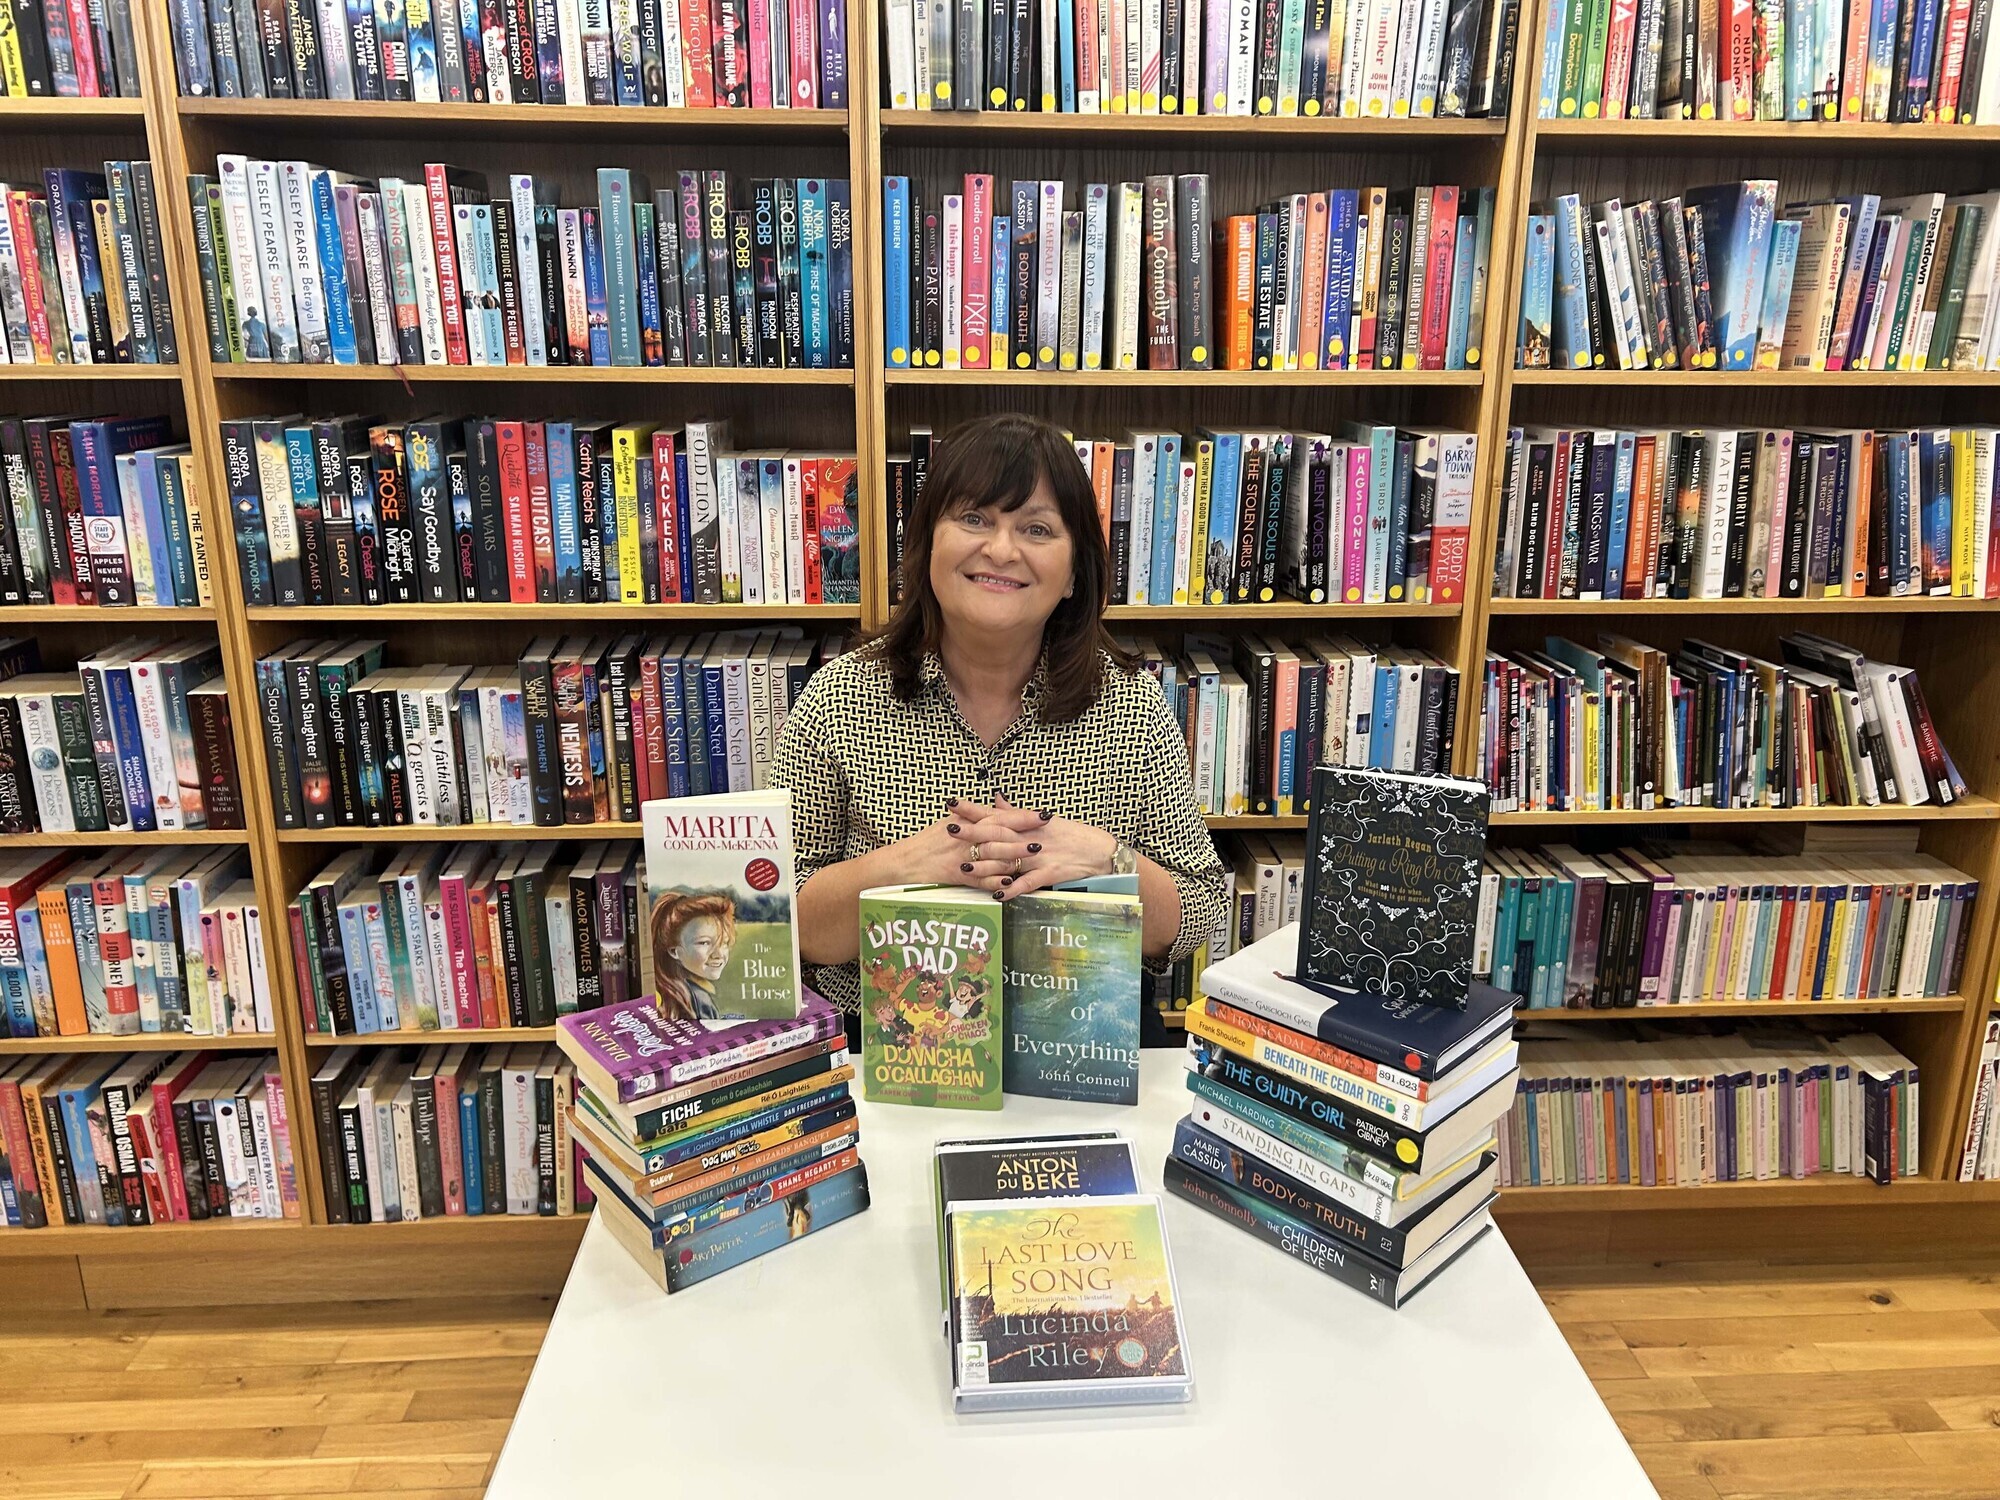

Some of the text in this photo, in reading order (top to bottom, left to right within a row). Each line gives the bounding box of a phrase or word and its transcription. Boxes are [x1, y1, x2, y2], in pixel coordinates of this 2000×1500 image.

[263, 9, 277, 58] PARETSKY
[270, 20, 281, 46] SARA
[390, 41, 409, 82] COUNT
[256, 172, 287, 329] LESLEY PEARSE Suspects
[1152, 198, 1169, 321] John Connolly
[1916, 208, 1941, 285] breakdown
[293, 222, 318, 323] PEARSE Betrayal
[926, 266, 938, 306] PARK
[1328, 237, 1344, 324] FIFTH AVENUE
[964, 294, 987, 338] FIXER
[1260, 264, 1272, 331] THE ESTATE
[693, 439, 709, 525] OLD LION
[1688, 449, 1701, 495] WINDFALL
[1737, 450, 1751, 529] THE MAJORITY
[376, 469, 399, 521] ROSE
[657, 447, 674, 554] HACKER
[1264, 468, 1283, 561] BROKEN SOULS
[1313, 469, 1325, 558] SILENT VOICES
[1353, 452, 1366, 551] HAGSTONE
[1708, 439, 1732, 558] MATRIARCH
[508, 495, 526, 580] SALMAN RUSHDIE
[530, 485, 551, 554] OUTCAST
[555, 483, 575, 557] MANHUNTER
[1240, 485, 1258, 568] STOLEN GIRLS
[66, 512, 91, 583] SHADOW STATE
[92, 558, 124, 566] APPLES
[243, 527, 261, 592] NIGHTWORK
[335, 538, 350, 579] LEGACY
[359, 536, 374, 581] Cheater
[1435, 537, 1450, 584] DOYLE
[1451, 537, 1466, 585] RODDY
[96, 566, 123, 574] NEVER
[102, 576, 121, 585] FALL
[267, 687, 283, 749] Slaughter
[561, 723, 582, 787] NEMESIS
[1282, 733, 1292, 793] SISTERHOOD
[390, 773, 403, 810] FALLEN
[413, 758, 428, 807] genesis
[435, 749, 450, 804] faithless
[663, 840, 778, 851] CONLON-McKENNA
[664, 816, 777, 838] MARITA
[1367, 833, 1431, 853] Jarlath Regan
[1335, 843, 1461, 887] Putting Ring On It
[1357, 885, 1431, 903] attempting married
[1365, 879, 1422, 896] What not when
[575, 888, 592, 973] AMOR TOWLES
[752, 944, 771, 953] The
[868, 919, 989, 950] DISASTER
[1040, 926, 1088, 948] The
[105, 939, 125, 987] JOURNEY
[452, 949, 469, 1010] The Teacher
[743, 960, 786, 979] Blue
[902, 946, 958, 974] DAD
[1002, 964, 1079, 991] Stream
[741, 984, 791, 1000] Horse
[1070, 1002, 1097, 1021] of
[779, 1030, 810, 1045] KINNEY
[950, 1019, 988, 1034] CHICKEN
[958, 1030, 987, 1040] CHAOS
[884, 1044, 974, 1068] DONNCHA
[1012, 1033, 1140, 1071] Everything
[1199, 1021, 1393, 1111] Frank Shouldice BENEATH THE CEDAR TREE
[876, 1066, 984, 1088] O'CALLAGHAN
[1039, 1069, 1130, 1087] John Connell
[1224, 1059, 1346, 1129] THE GUILTY GIRL
[1378, 1070, 1417, 1092] 891.623
[418, 1092, 432, 1146] Trollope
[662, 1094, 728, 1125] FICHE Colm
[692, 1135, 725, 1152] JOHNSON
[729, 1124, 749, 1139] FINAL
[750, 1112, 780, 1130] WHISTLE
[783, 1108, 796, 1117] DAN
[797, 1096, 826, 1112] FREEDMAN
[1197, 1082, 1274, 1129] MICHAEL HARDING
[1402, 1104, 1410, 1121] SHO
[111, 1090, 132, 1173] RICHARD OSMAN
[343, 1113, 360, 1180] THE LONG KNIVES
[755, 1146, 793, 1164] WIZARDS'
[794, 1131, 830, 1150] BANQUET
[1194, 1138, 1220, 1157] MARIE
[1356, 1118, 1389, 1140] PATRICIA
[1357, 1129, 1388, 1147] GIBNEY
[539, 1133, 553, 1177] WINNER
[702, 1155, 719, 1170] DOG
[721, 1148, 737, 1162] MAN
[777, 1174, 802, 1190] SHANE
[805, 1159, 837, 1178] HEGARTY
[997, 1157, 1077, 1176] ANTON
[1183, 1144, 1227, 1173] CASSIDY
[1222, 1118, 1356, 1198] STANDING IN GAPS
[673, 1198, 697, 1212] DUBLIN
[700, 1189, 713, 1203] FOLK
[717, 1180, 734, 1194] TALES
[735, 1176, 746, 1188] FOR
[749, 1165, 777, 1182] CHILDREN
[997, 1172, 1081, 1191] DU BEKE
[1183, 1178, 1257, 1227] John Connolly
[1021, 1213, 1085, 1240] The
[1253, 1172, 1367, 1240] BODY OF TRUTH
[663, 1217, 697, 1244] BOOT
[700, 1214, 708, 1222] THE
[1267, 1220, 1345, 1267] THE CHILDREN
[981, 1240, 1137, 1265] LAST LOVE
[1281, 1239, 1325, 1270] OF EVE
[1011, 1267, 1113, 1294] SONG
[1026, 1295, 1065, 1304] International
[1003, 1309, 1131, 1336] Lucinda
[1027, 1343, 1111, 1373] Riley
